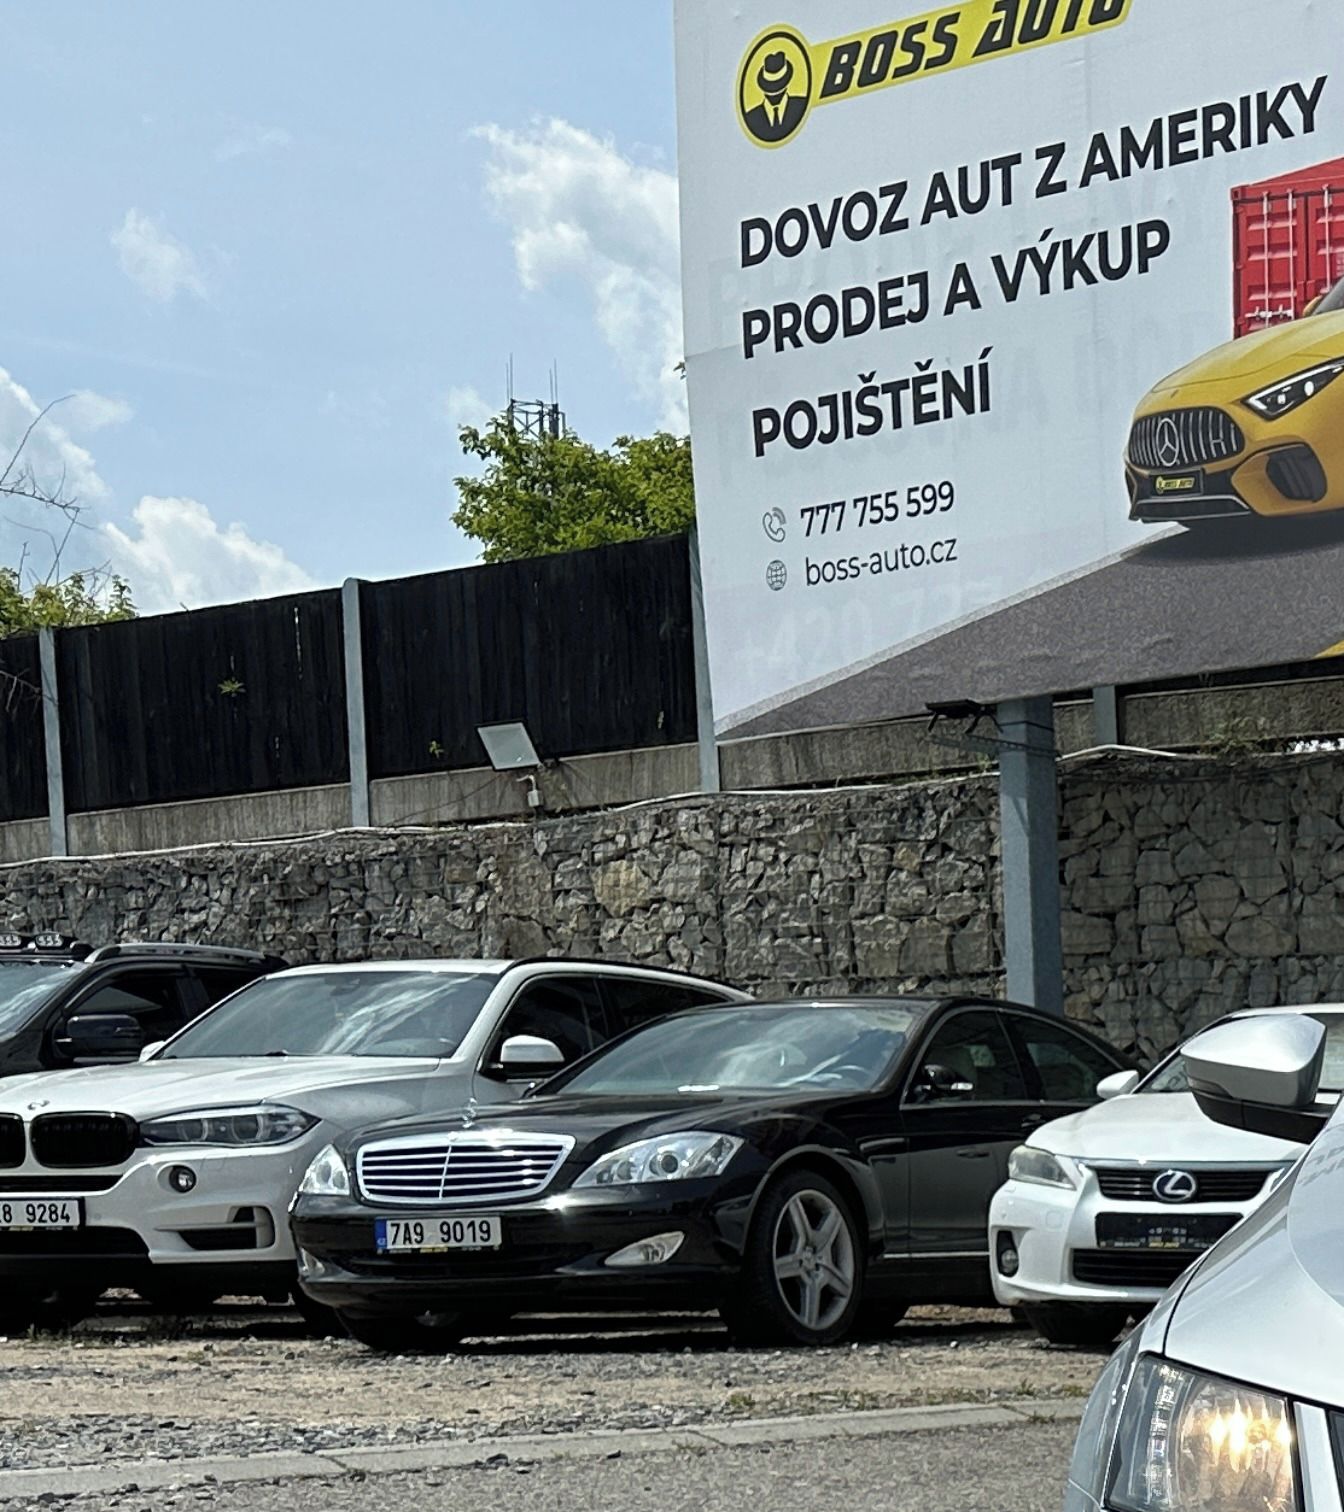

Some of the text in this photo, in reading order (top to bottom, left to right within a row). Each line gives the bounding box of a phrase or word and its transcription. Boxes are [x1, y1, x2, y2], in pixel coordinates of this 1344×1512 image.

[820, 12, 961, 99] BOSS
[741, 75, 1328, 268] DOVOZ AUT Z AMERIKY
[743, 220, 1170, 359] PRODEJ A VÝKUP
[753, 346, 993, 457] POJIŠTĚNÍ
[801, 481, 955, 538] 777 755 599
[806, 538, 958, 587] boss-auto.cz
[26, 1203, 70, 1223] 9284
[390, 1220, 491, 1246] 7A9 9019
